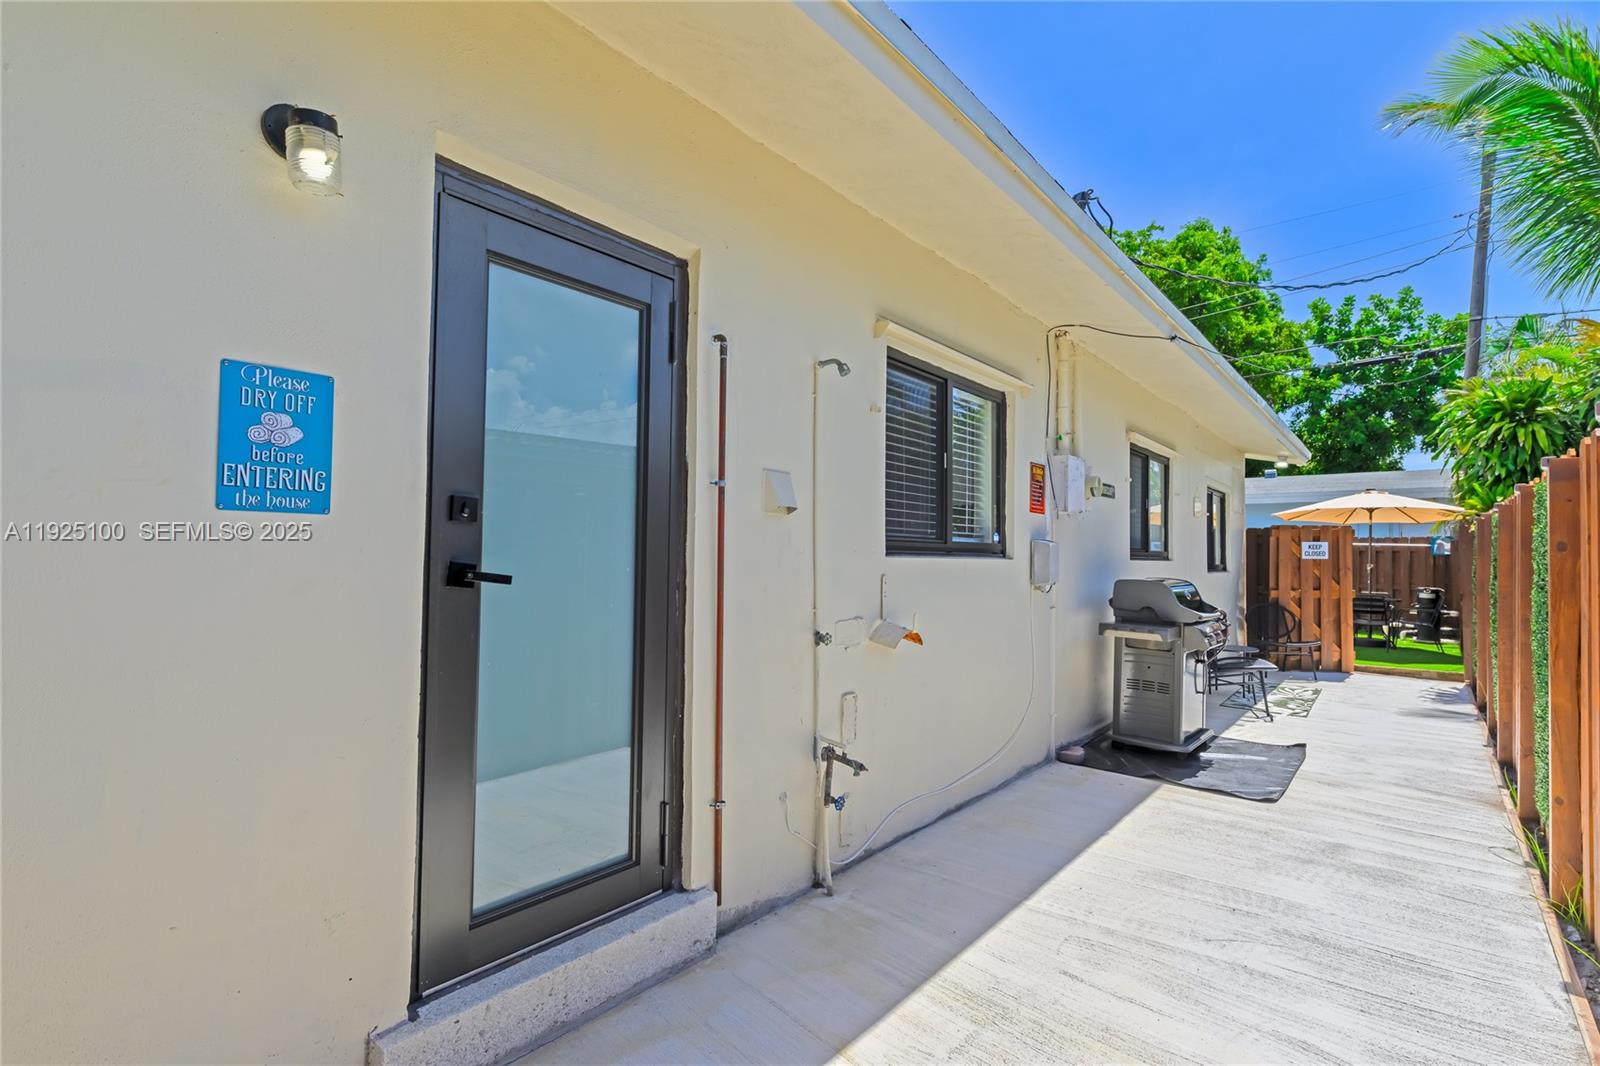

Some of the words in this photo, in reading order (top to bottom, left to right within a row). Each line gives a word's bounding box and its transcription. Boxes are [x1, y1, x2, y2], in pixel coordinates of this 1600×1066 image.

[240, 364, 310, 392] Please
[240, 386, 277, 410] DRY
[284, 393, 316, 414] OFF
[251, 445, 304, 465] before
[223, 462, 326, 492] ENTERING
[235, 489, 261, 509] the
[266, 491, 311, 510] house
